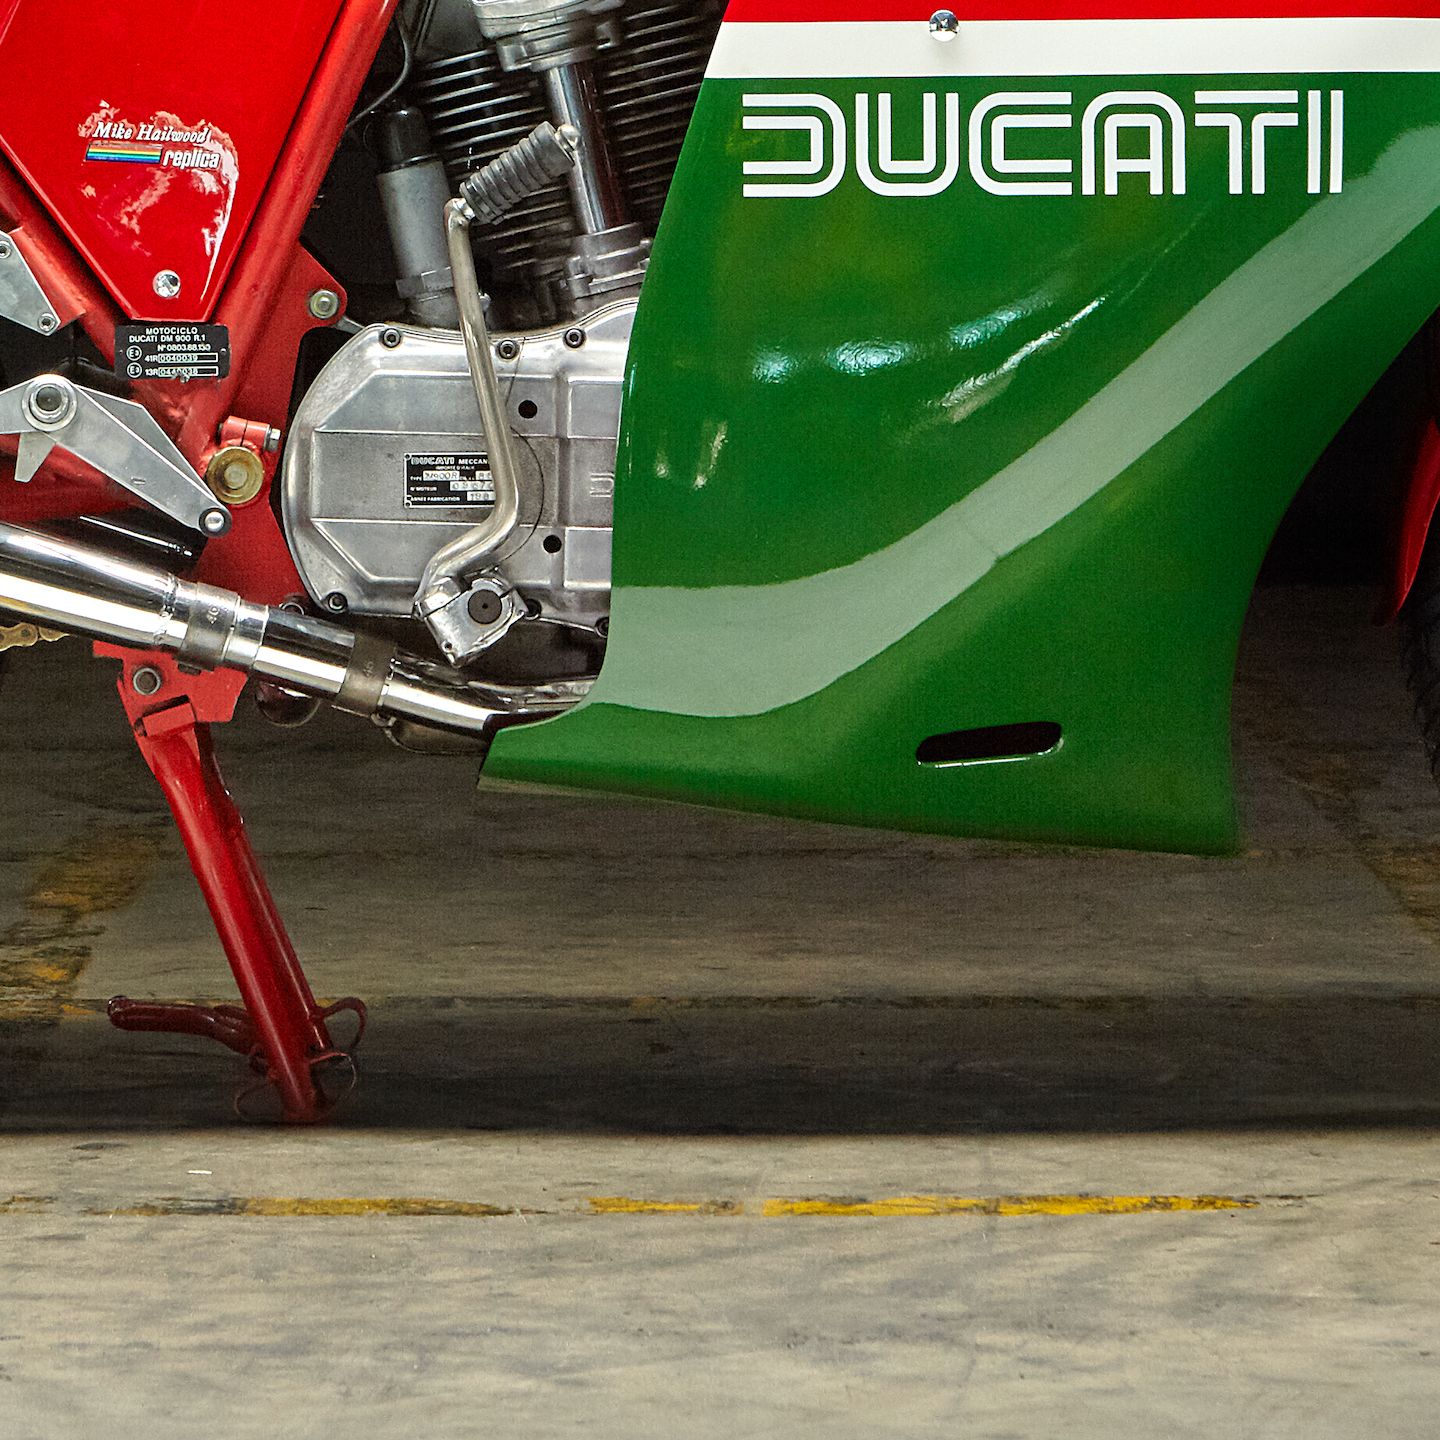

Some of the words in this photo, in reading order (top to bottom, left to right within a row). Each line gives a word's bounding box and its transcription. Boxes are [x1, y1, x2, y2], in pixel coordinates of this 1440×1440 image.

[92, 121, 133, 140] Mike
[136, 124, 211, 144] Hailwood
[742, 88, 1345, 198] DUCATI
[163, 149, 220, 170] replica
[129, 335, 158, 343] DUCATI
[160, 335, 173, 343] DM
[145, 327, 198, 335] MOTOCICLO
